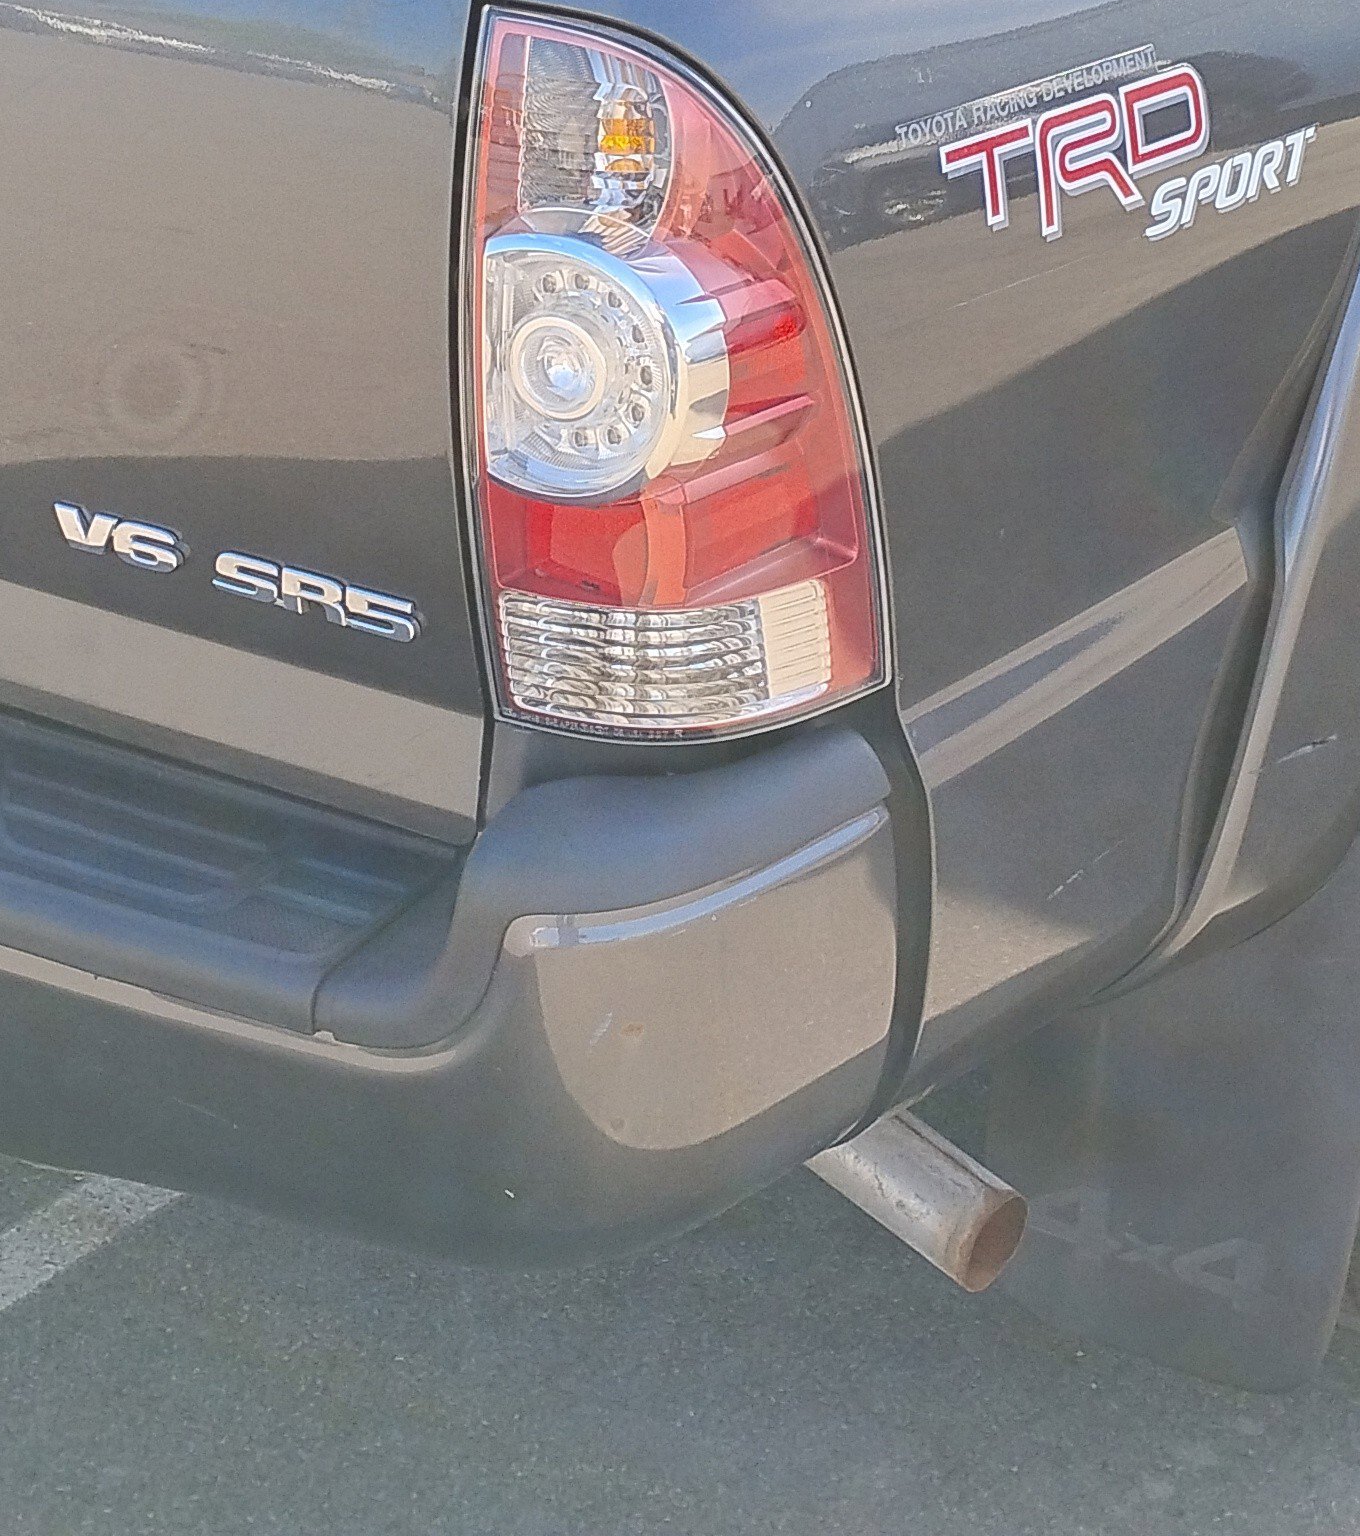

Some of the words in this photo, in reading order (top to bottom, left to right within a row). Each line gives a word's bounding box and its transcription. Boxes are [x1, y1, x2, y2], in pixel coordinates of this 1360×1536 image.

[895, 108, 967, 144] TOYOTA
[971, 87, 1038, 125] RACING
[1040, 47, 1158, 102] DEVELOPMENT
[940, 62, 1209, 240] TRD
[1145, 124, 1316, 240] SPORT
[53, 501, 186, 573] V6
[211, 549, 422, 643] SR5
